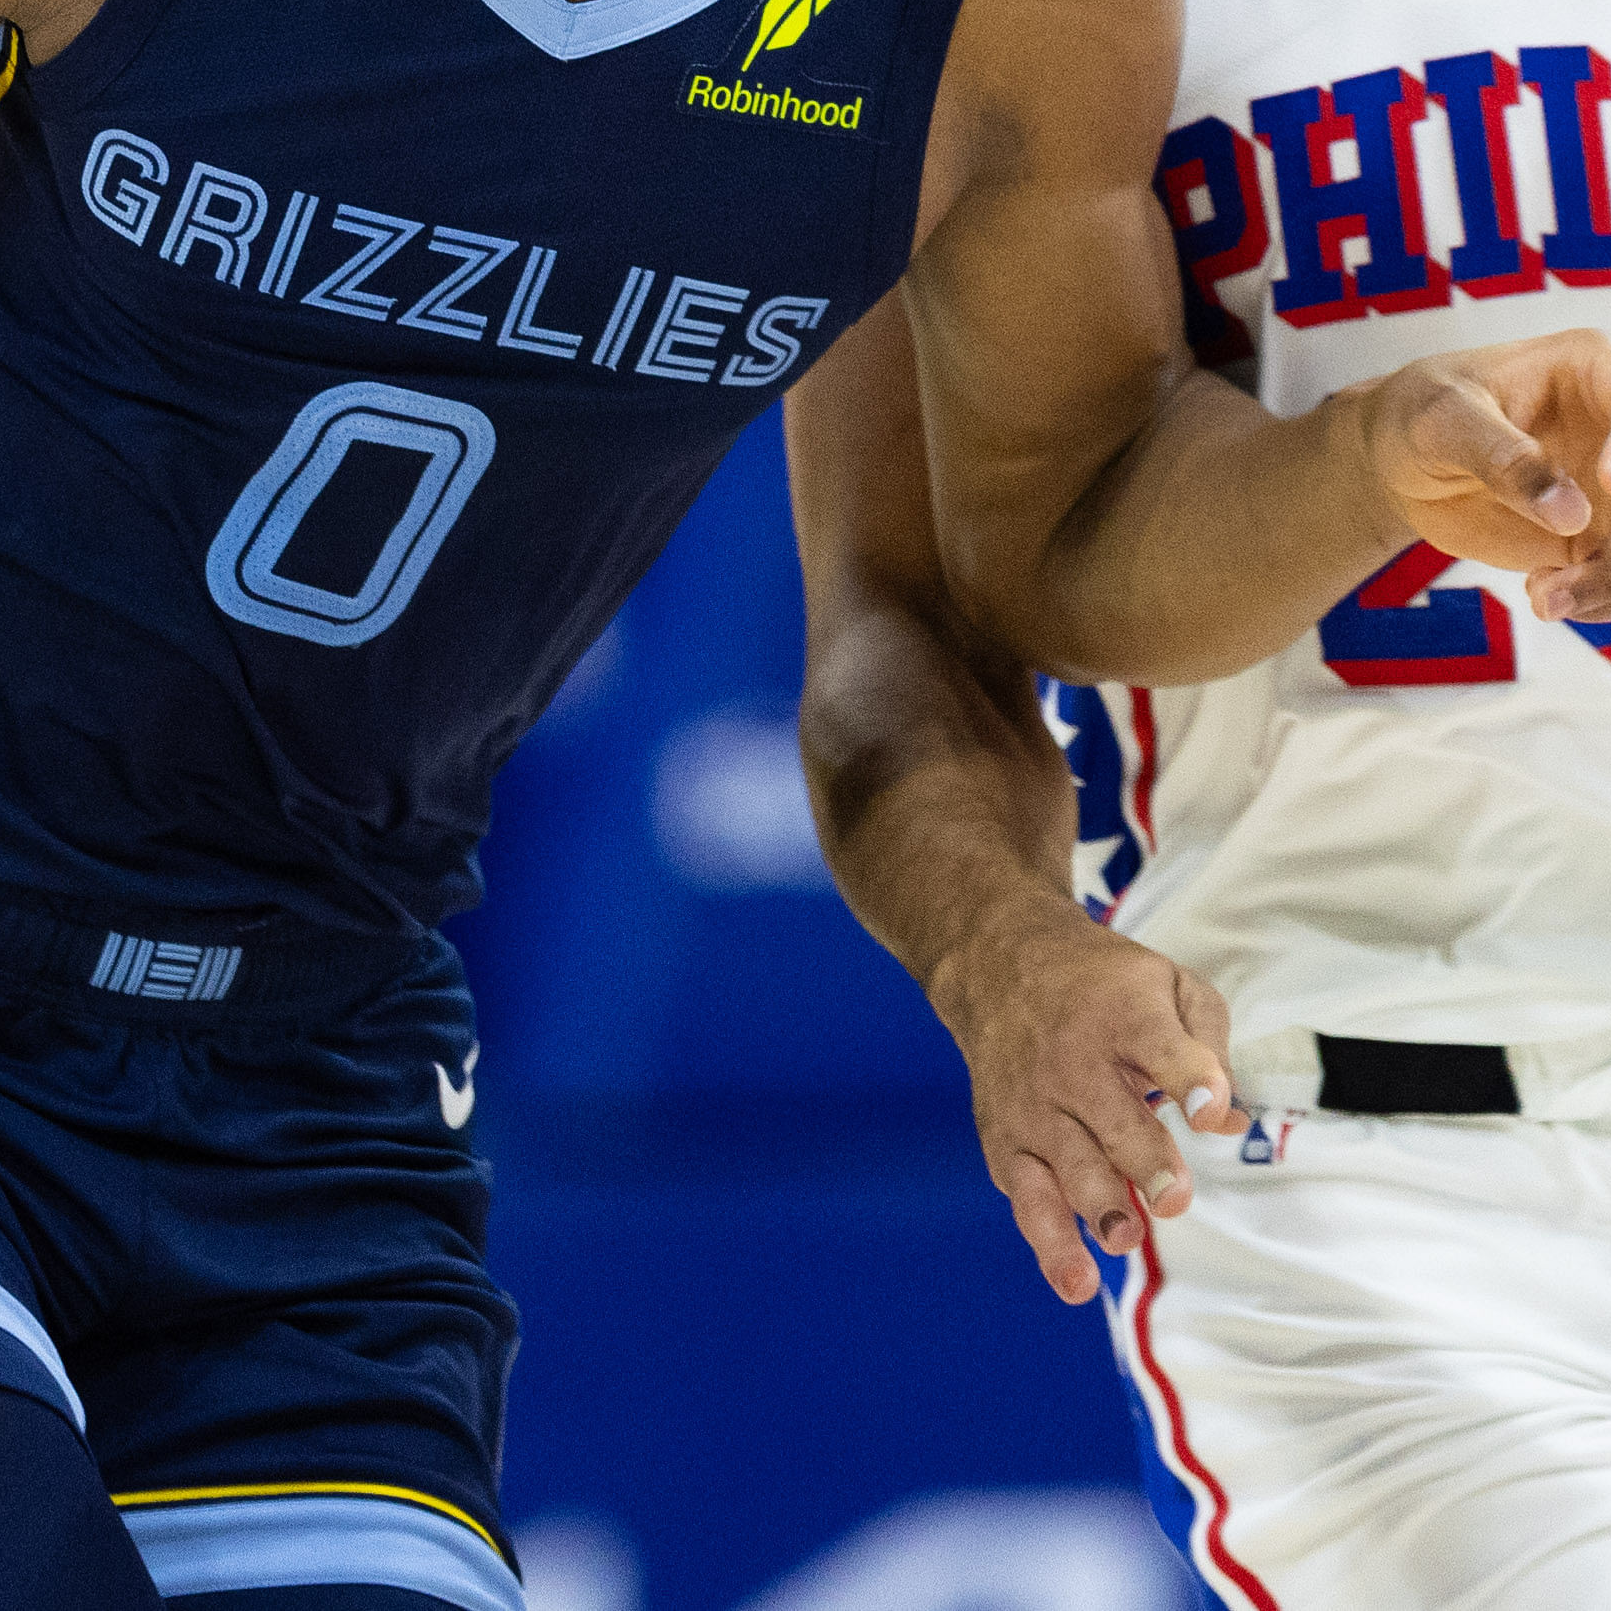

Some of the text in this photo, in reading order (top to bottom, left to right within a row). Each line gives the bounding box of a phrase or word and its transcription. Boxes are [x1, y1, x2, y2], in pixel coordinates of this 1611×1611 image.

[687, 75, 863, 129] Robinhood
[81, 128, 830, 387] GRIZZLIES
[205, 380, 497, 649] 0
